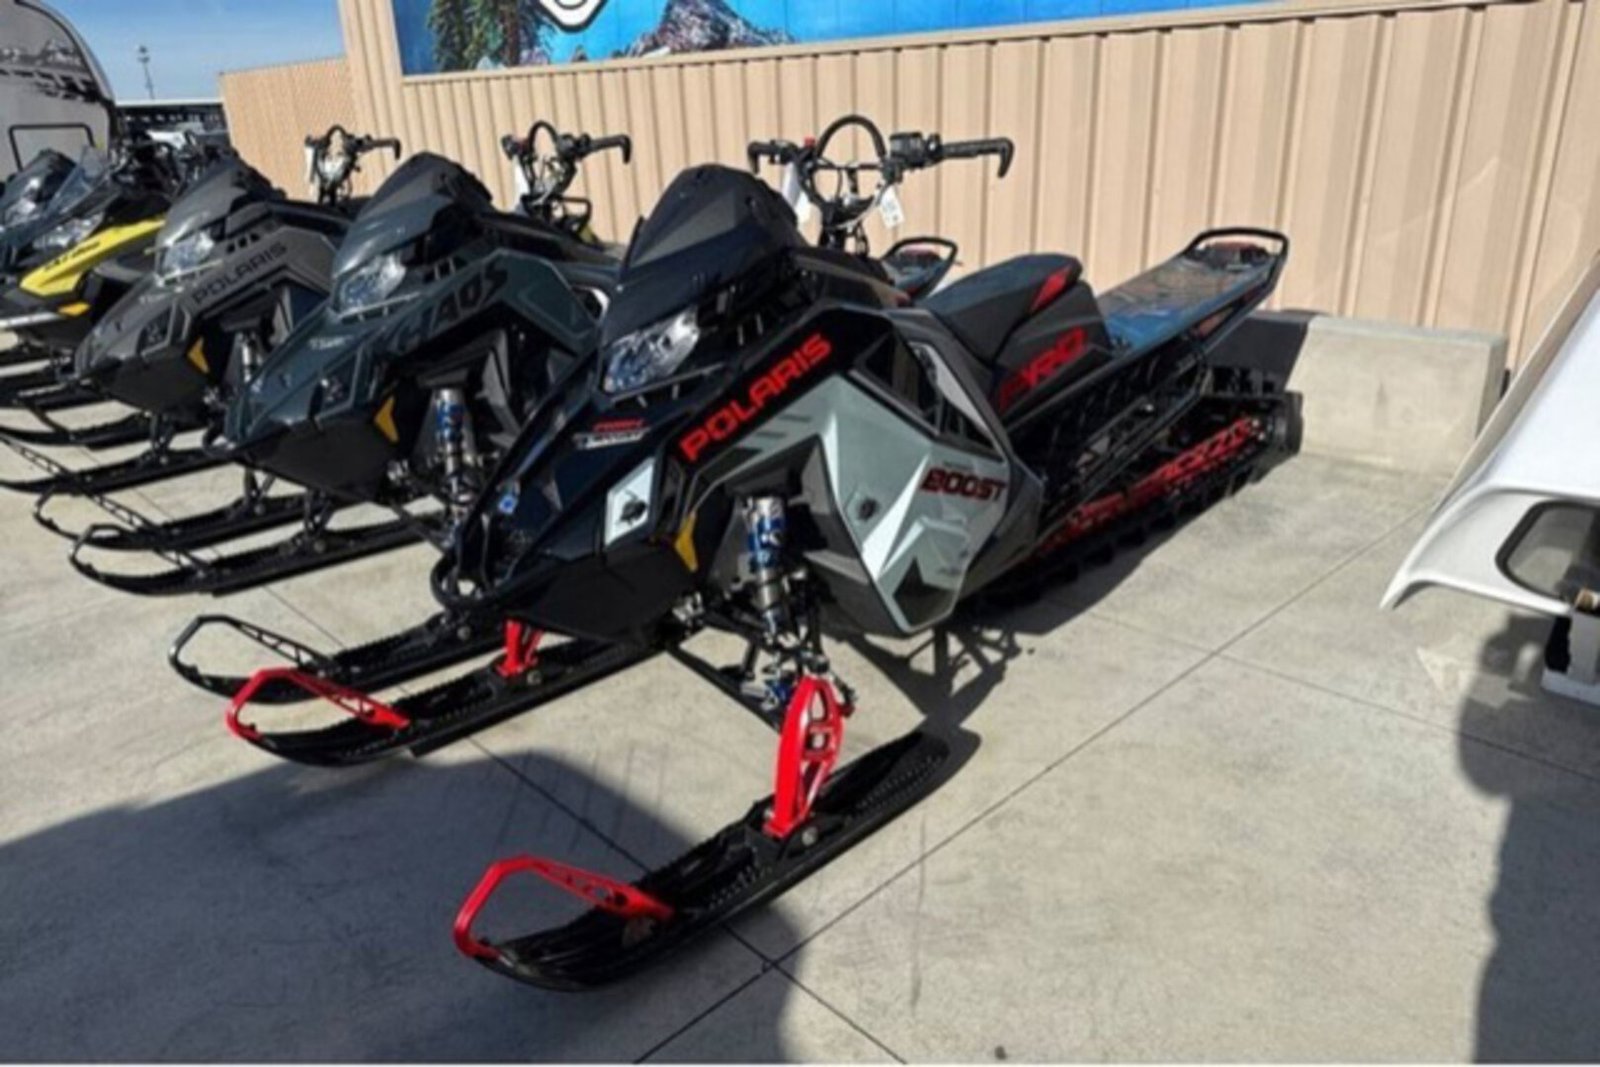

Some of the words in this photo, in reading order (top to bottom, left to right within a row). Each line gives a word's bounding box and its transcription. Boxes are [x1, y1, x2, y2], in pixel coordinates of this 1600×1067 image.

[192, 243, 287, 302] POLARIS
[680, 333, 832, 461] POLARIS
[920, 467, 1006, 501] BOOST
